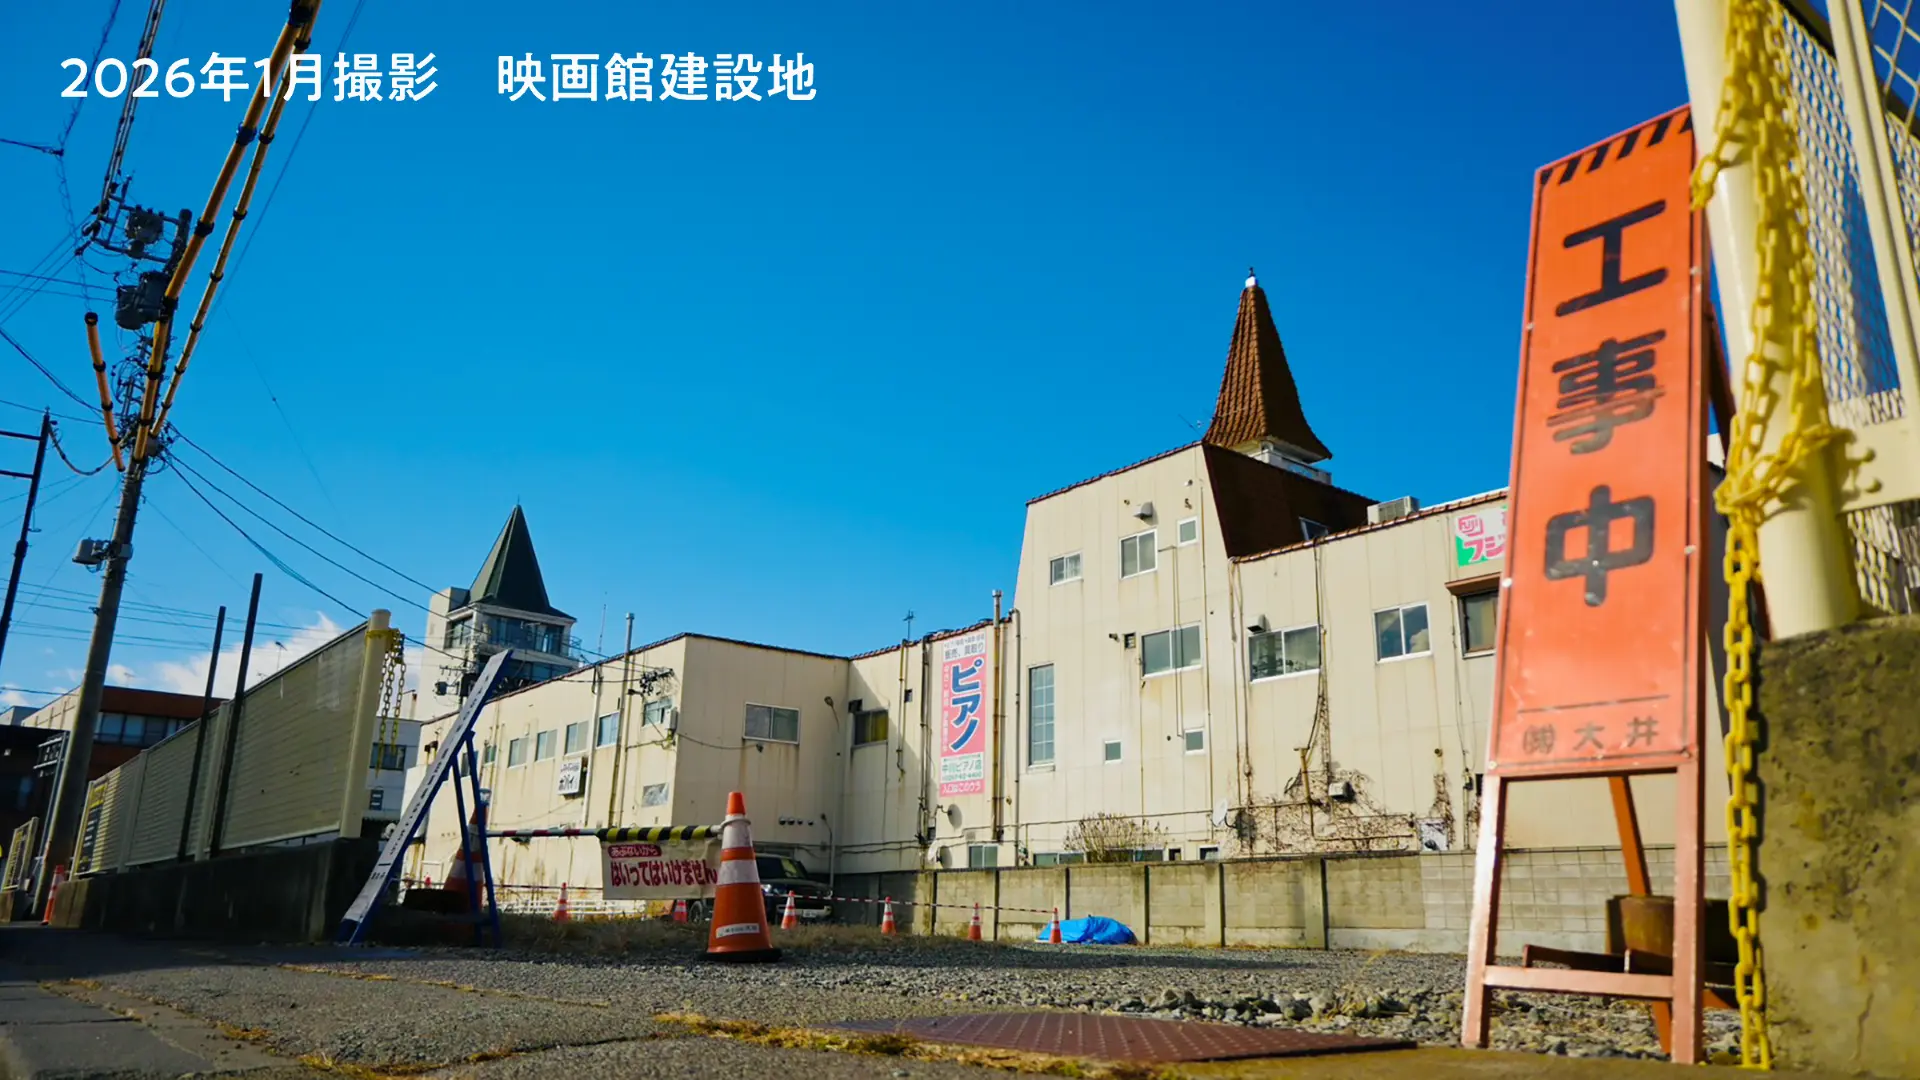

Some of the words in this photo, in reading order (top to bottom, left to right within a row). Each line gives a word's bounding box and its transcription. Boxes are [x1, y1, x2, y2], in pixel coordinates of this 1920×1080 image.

[1544, 199, 1667, 607] 工事中
[950, 658, 984, 752] ピアノ
[610, 859, 718, 887] はいってはいけません
[611, 846, 659, 857] あぶないから
